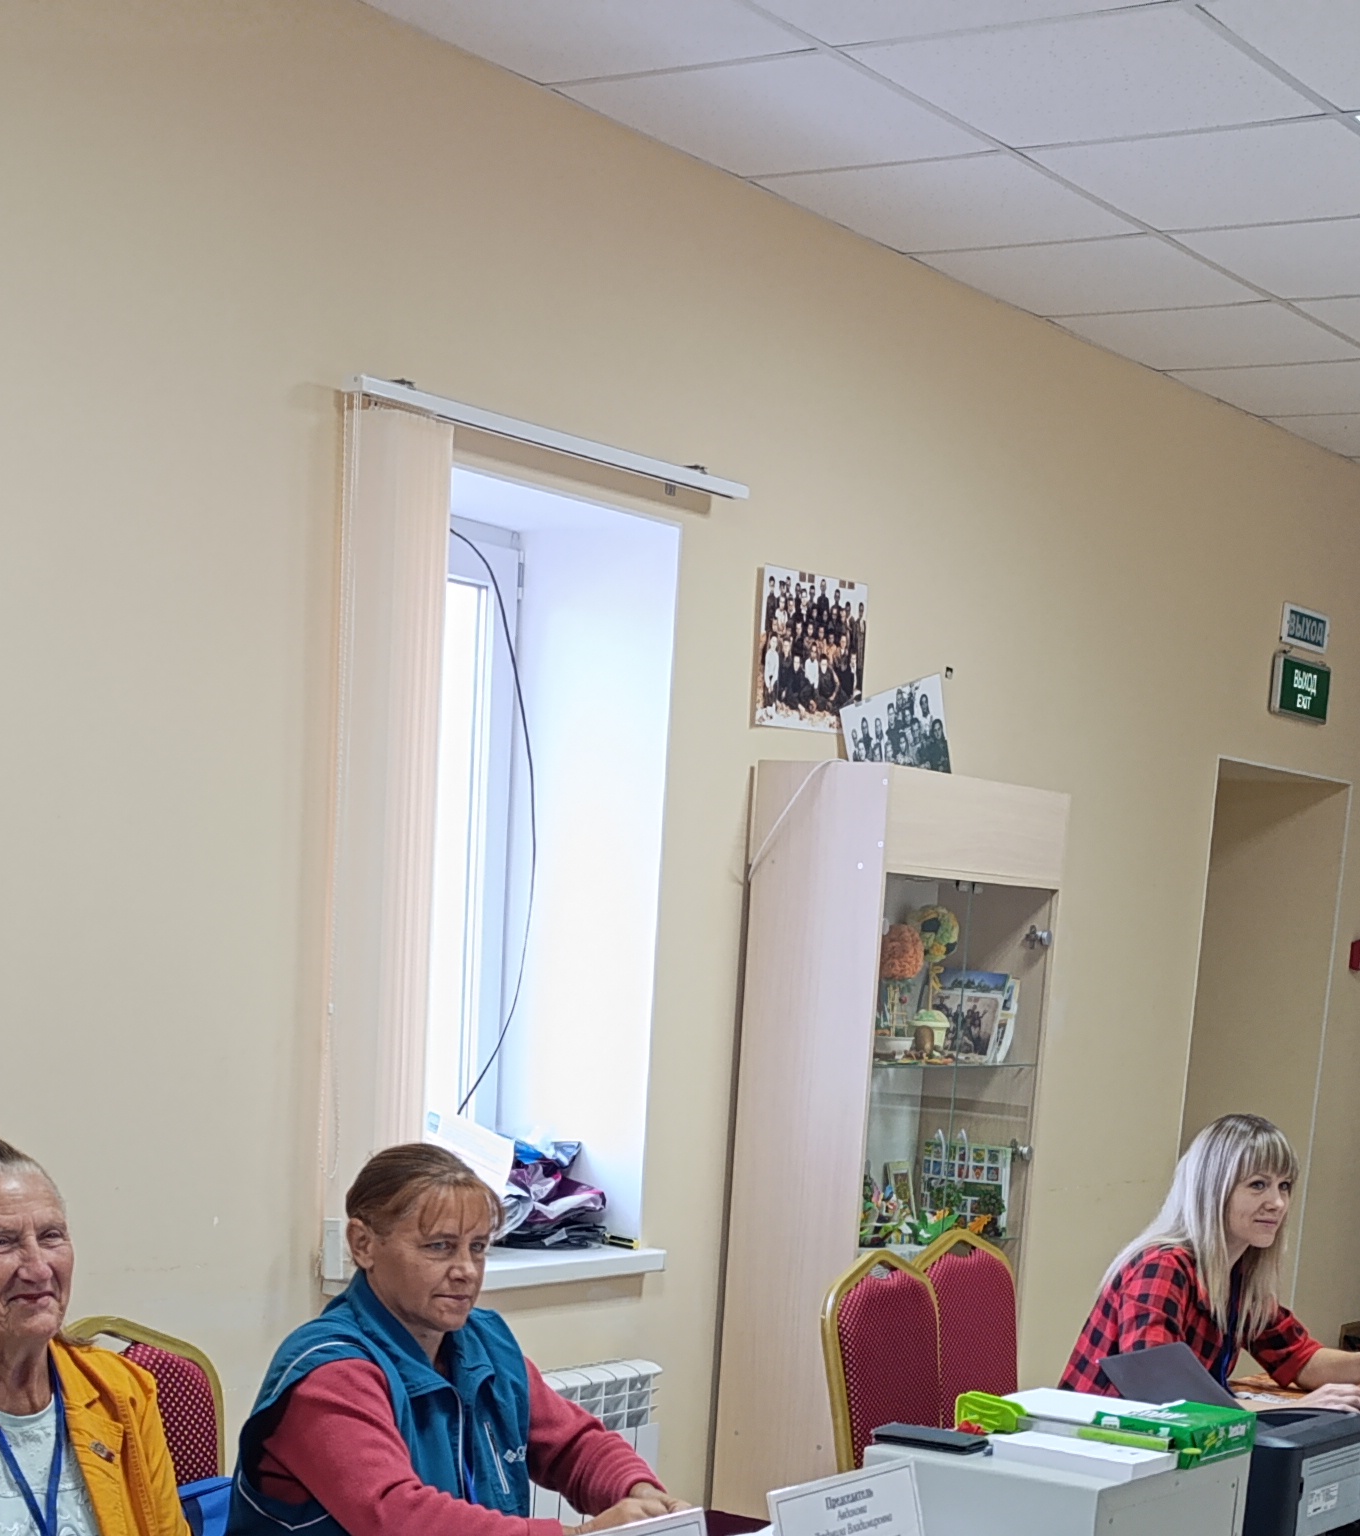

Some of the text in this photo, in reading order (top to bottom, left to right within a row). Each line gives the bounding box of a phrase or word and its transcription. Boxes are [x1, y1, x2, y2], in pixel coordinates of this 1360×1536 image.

[1288, 613, 1324, 645] ВЫХОД
[1293, 669, 1318, 697] ВЫХОД
[1296, 693, 1312, 710] EXIT
